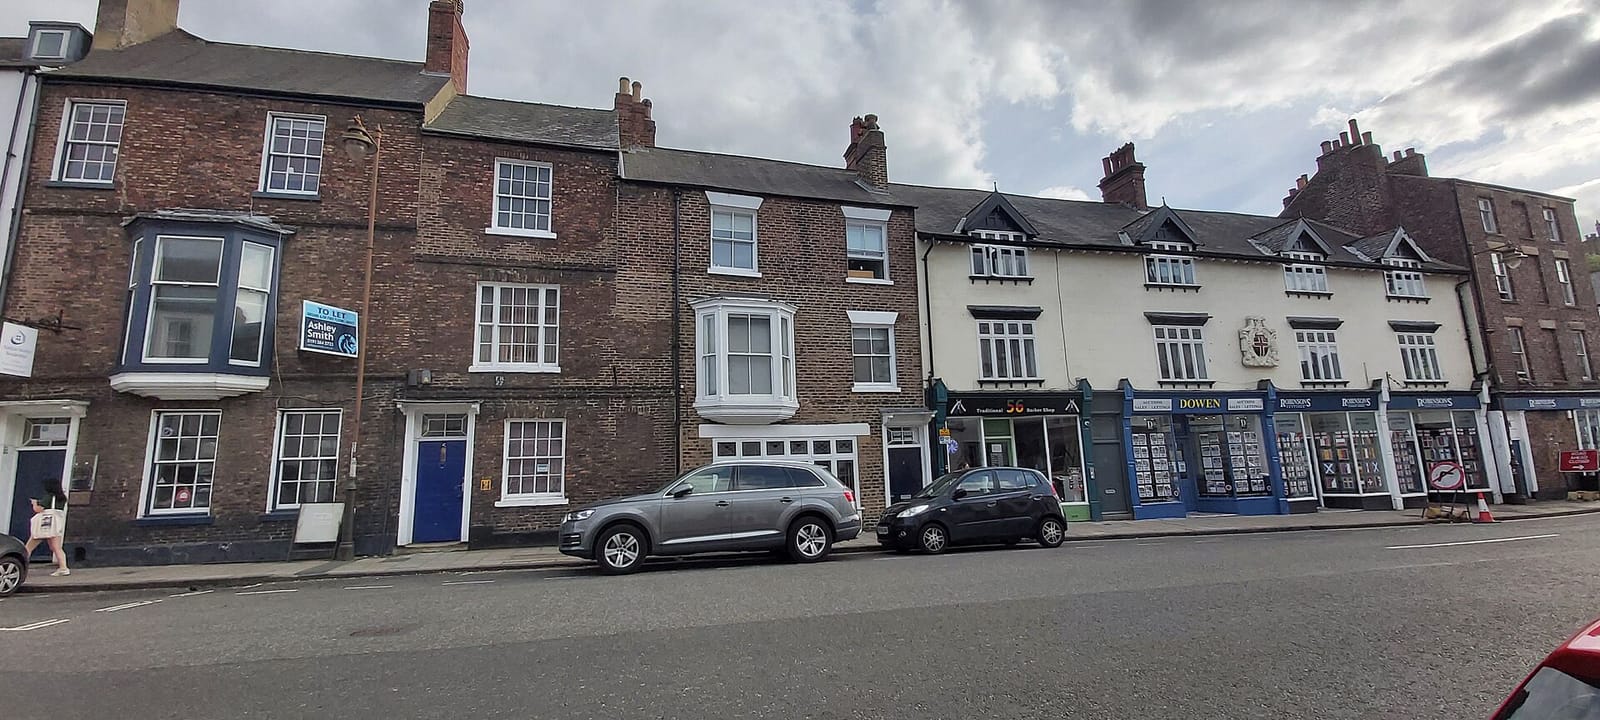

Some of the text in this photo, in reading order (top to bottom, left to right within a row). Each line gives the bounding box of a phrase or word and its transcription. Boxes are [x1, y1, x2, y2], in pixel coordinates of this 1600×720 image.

[317, 307, 330, 316] TO
[332, 310, 346, 319] LET
[308, 320, 337, 334] Ashley
[307, 329, 334, 341] Smith
[1007, 399, 1024, 414] 56
[1180, 399, 1221, 408] DOWEN
[1280, 398, 1312, 408] ROBINSONS
[1341, 398, 1371, 407] ROBINSONS
[1416, 398, 1453, 407] ROBINSONS
